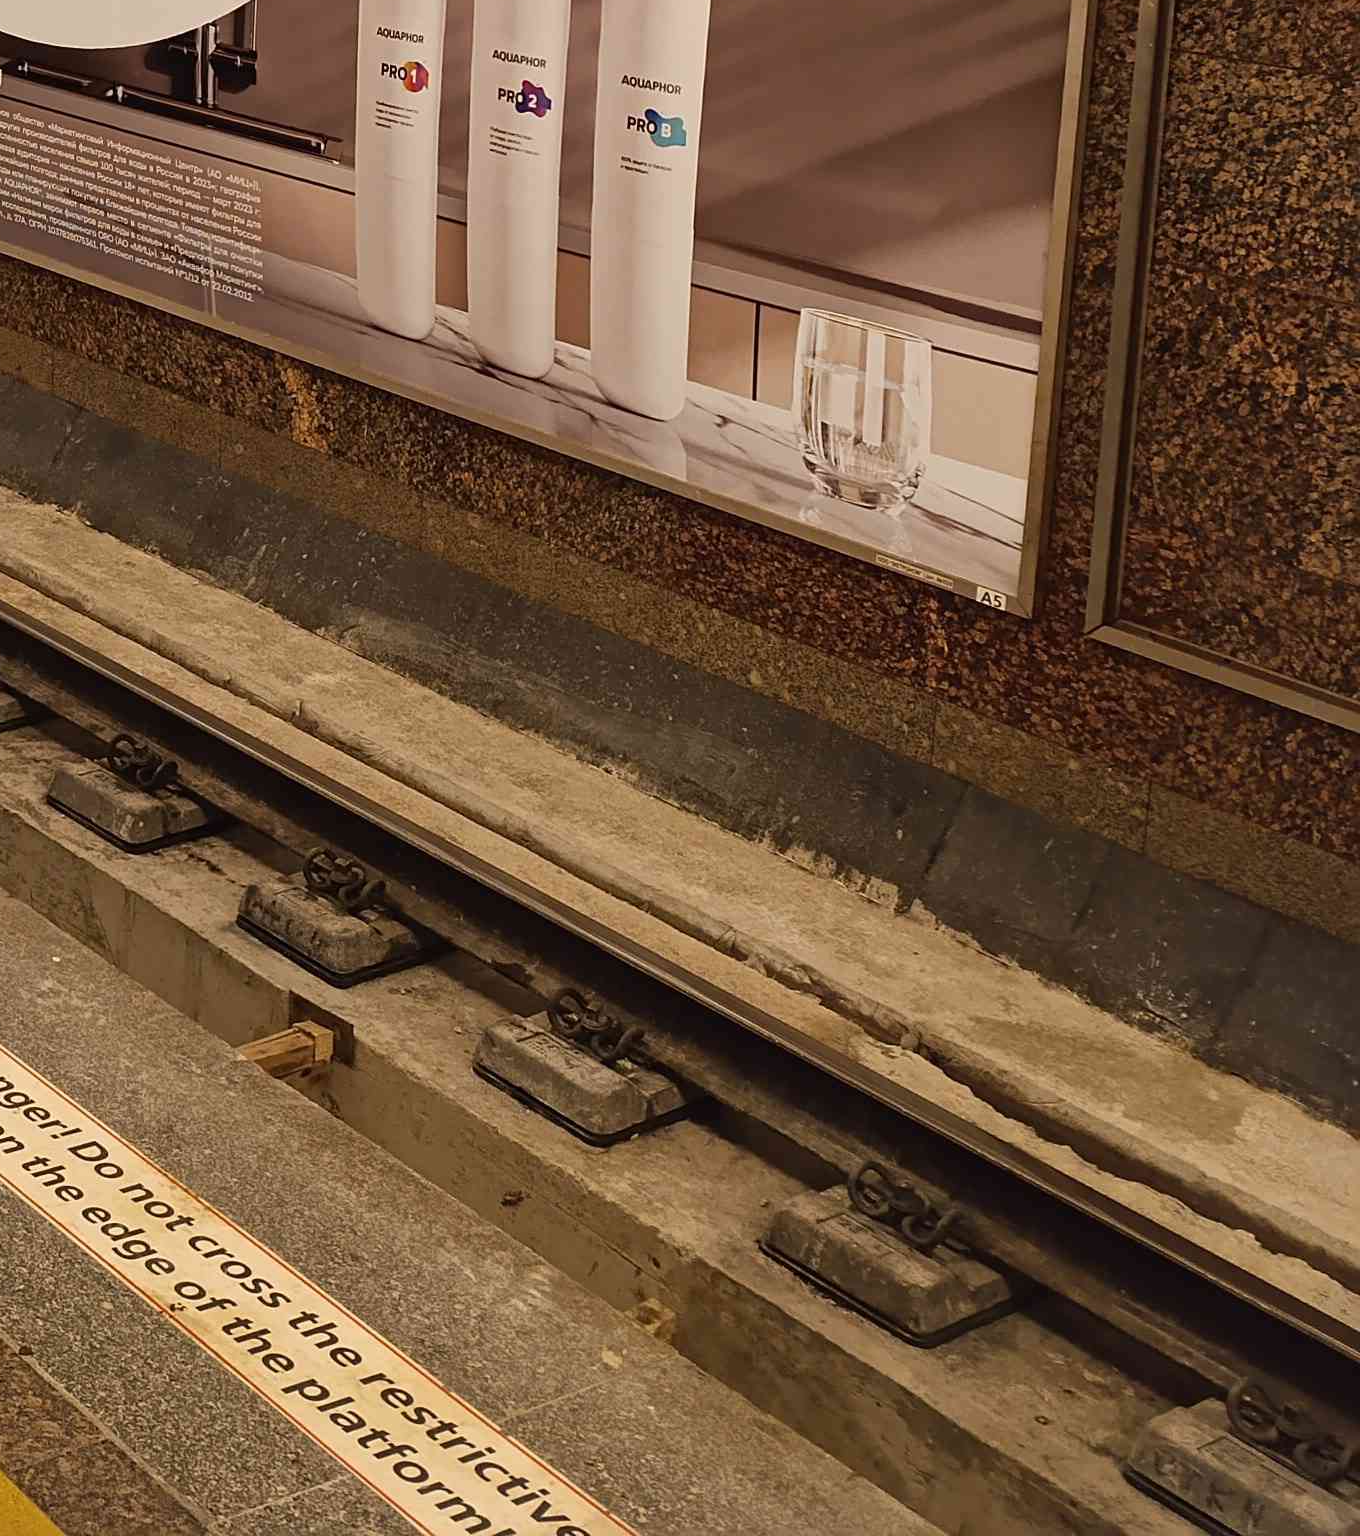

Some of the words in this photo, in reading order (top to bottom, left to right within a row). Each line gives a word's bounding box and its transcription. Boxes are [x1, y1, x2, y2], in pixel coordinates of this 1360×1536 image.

[376, 27, 424, 44] AQUAPHOR
[492, 49, 547, 69] AQUAPHOR
[621, 75, 682, 95] AQUAPHOR
[21, 1155, 84, 1202] the
[81, 1206, 177, 1276] edge
[173, 1280, 238, 1313] of
[221, 1316, 295, 1374] the
[67, 1140, 124, 1180] Do
[120, 1182, 196, 1232] not
[188, 1235, 292, 1309] cross
[288, 1311, 362, 1368] the
[360, 1372, 592, 1536] restrictive
